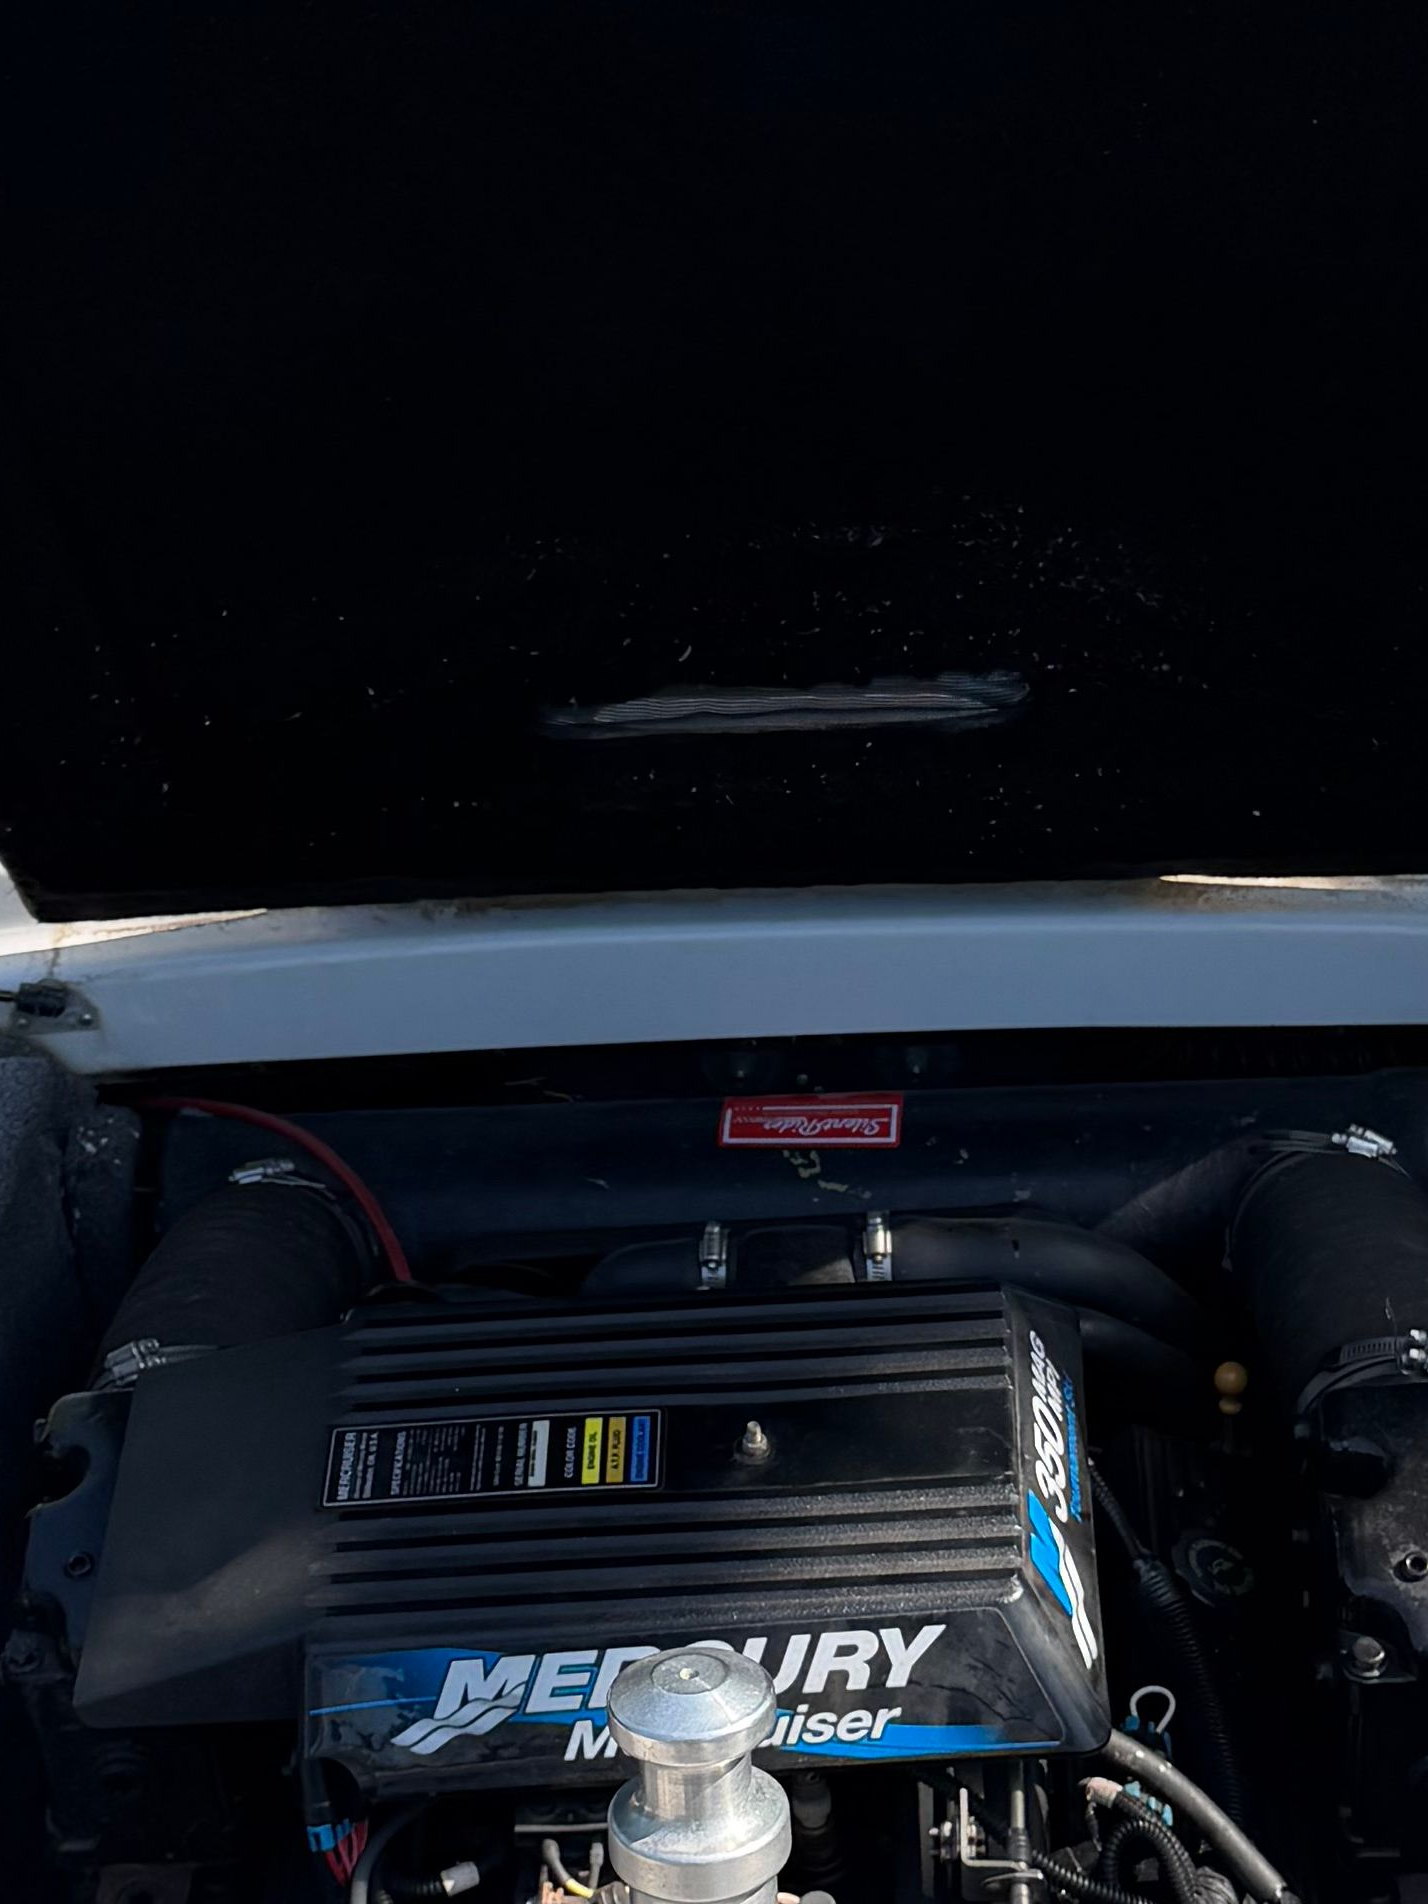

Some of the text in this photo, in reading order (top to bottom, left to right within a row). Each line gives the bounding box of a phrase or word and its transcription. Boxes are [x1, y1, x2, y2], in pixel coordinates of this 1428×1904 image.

[1030, 1329, 1047, 1403] MAG
[1046, 1357, 1063, 1422] MPI
[1032, 1395, 1068, 1524] 350
